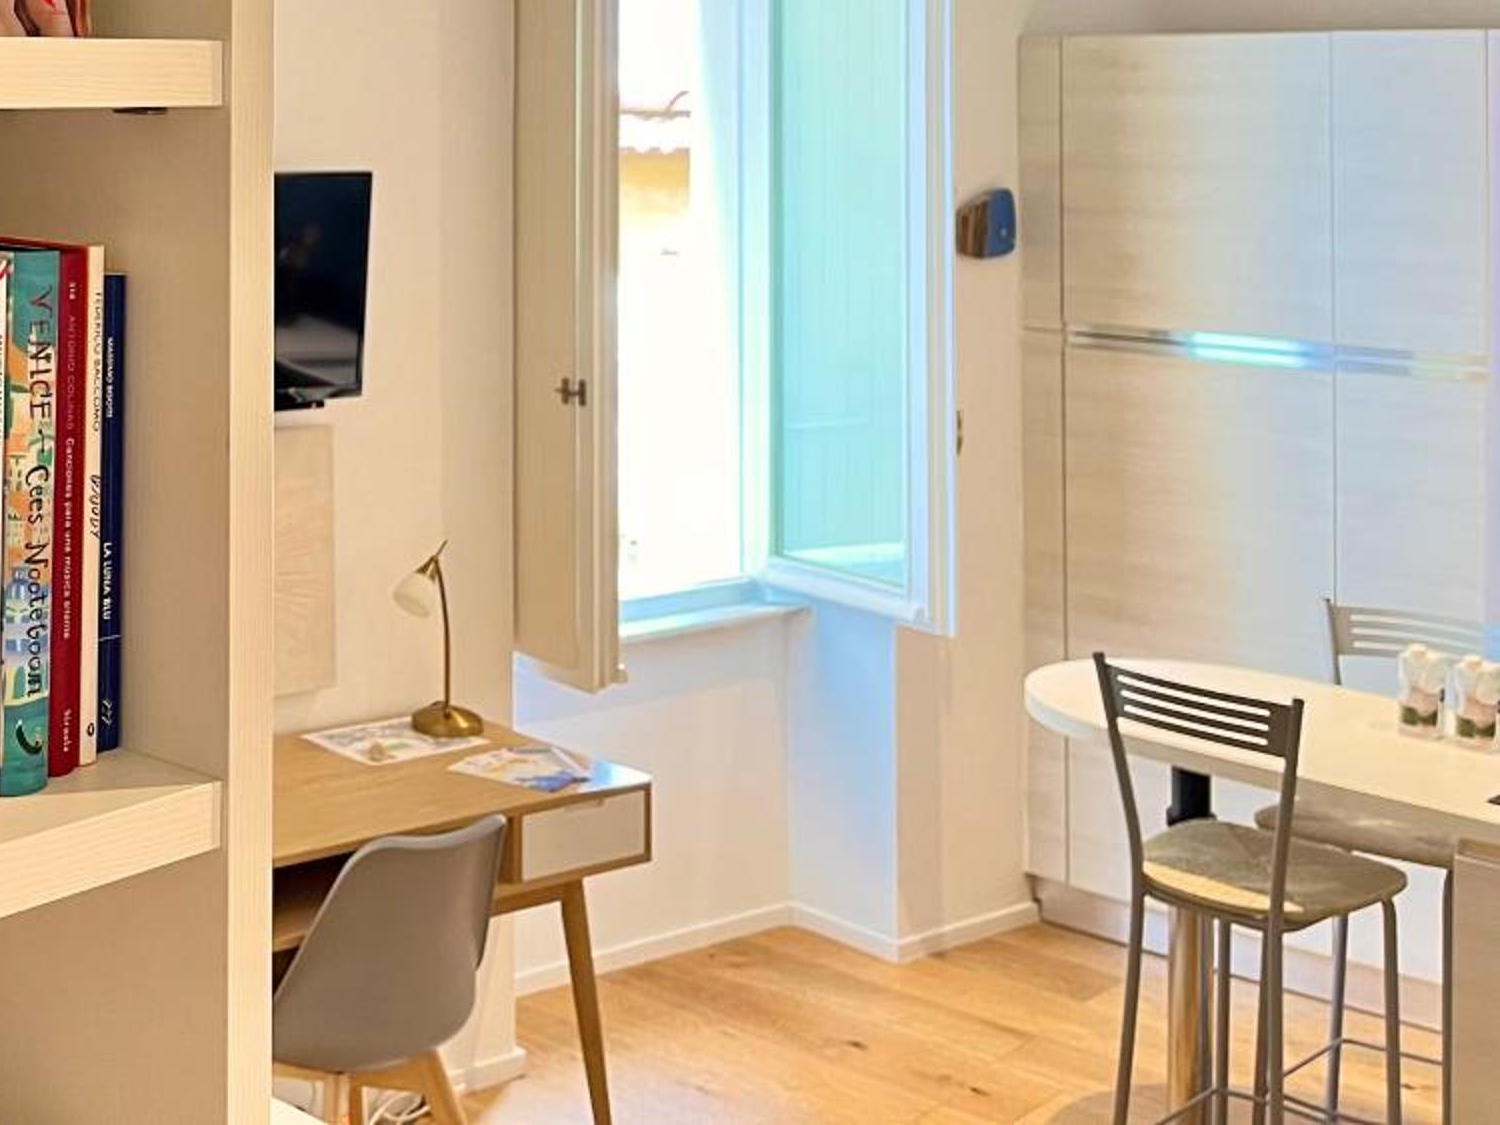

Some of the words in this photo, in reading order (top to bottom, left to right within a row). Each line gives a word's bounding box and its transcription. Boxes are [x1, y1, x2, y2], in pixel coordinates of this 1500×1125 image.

[28, 283, 53, 420] VENICE
[64, 437, 75, 498] Canciones
[25, 464, 50, 527] Cees
[63, 531, 72, 553] una
[103, 542, 113, 559] LA
[102, 560, 112, 596] LUNA
[24, 540, 51, 698] Nooteboom
[101, 597, 112, 621] BLU
